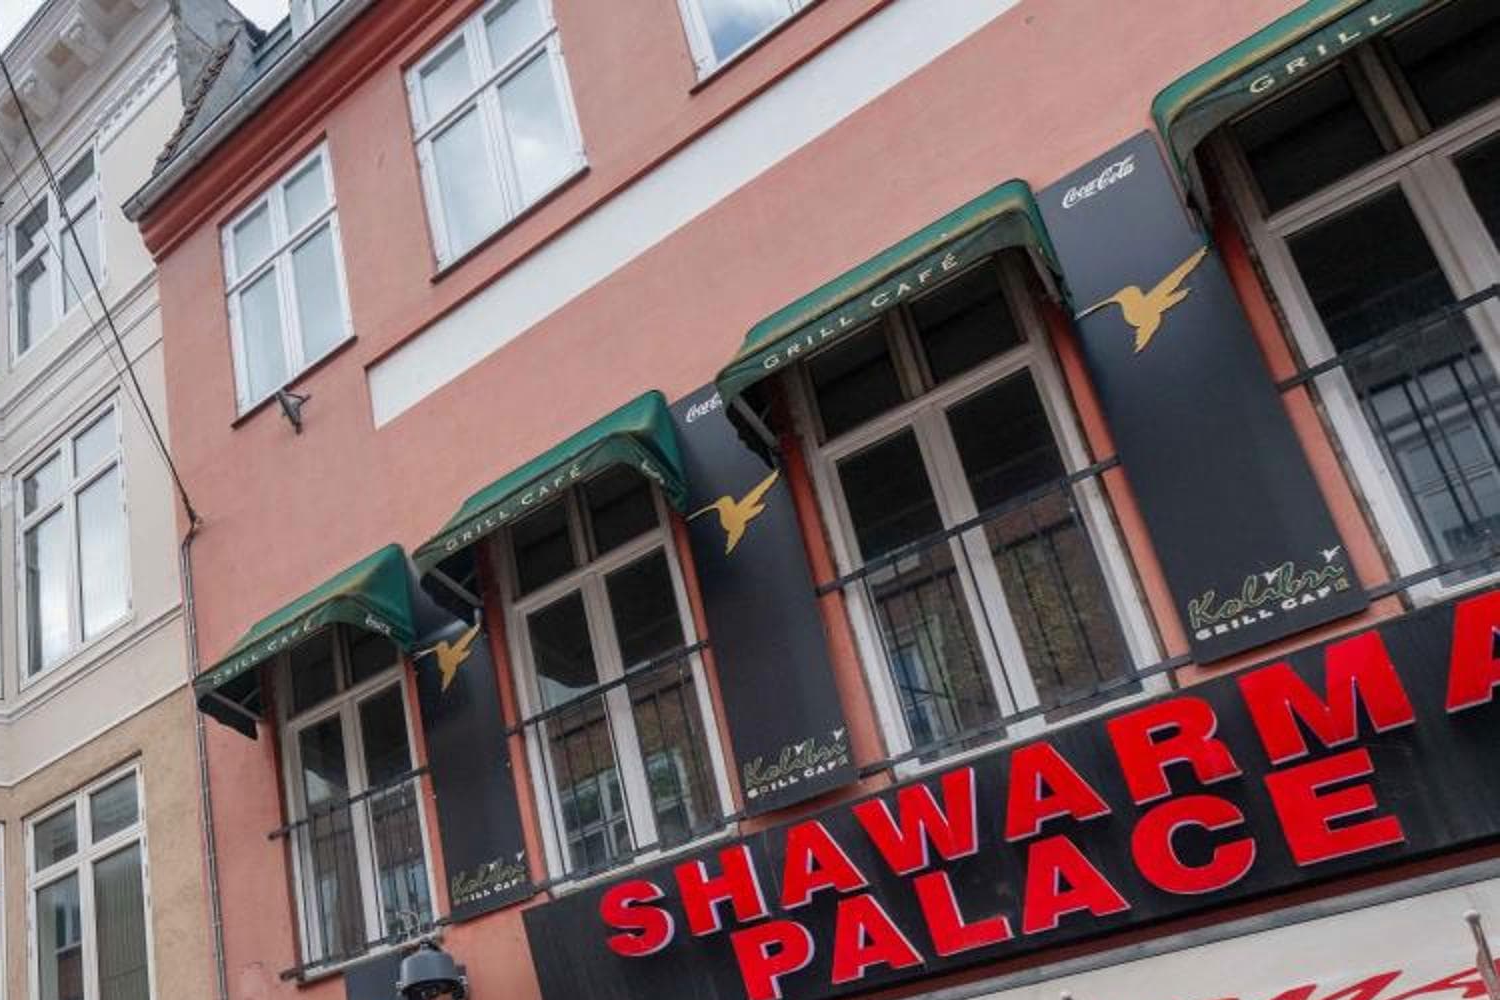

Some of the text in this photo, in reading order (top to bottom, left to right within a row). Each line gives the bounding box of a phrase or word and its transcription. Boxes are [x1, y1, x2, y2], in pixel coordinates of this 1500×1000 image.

[1249, 11, 1393, 94] GRILL
[1062, 154, 1137, 209] Coca-Cola
[763, 252, 960, 370] GRILL CAFÉ
[445, 511, 511, 551] GRILL
[1196, 609, 1275, 640] GRILL
[747, 775, 799, 799] GRILL
